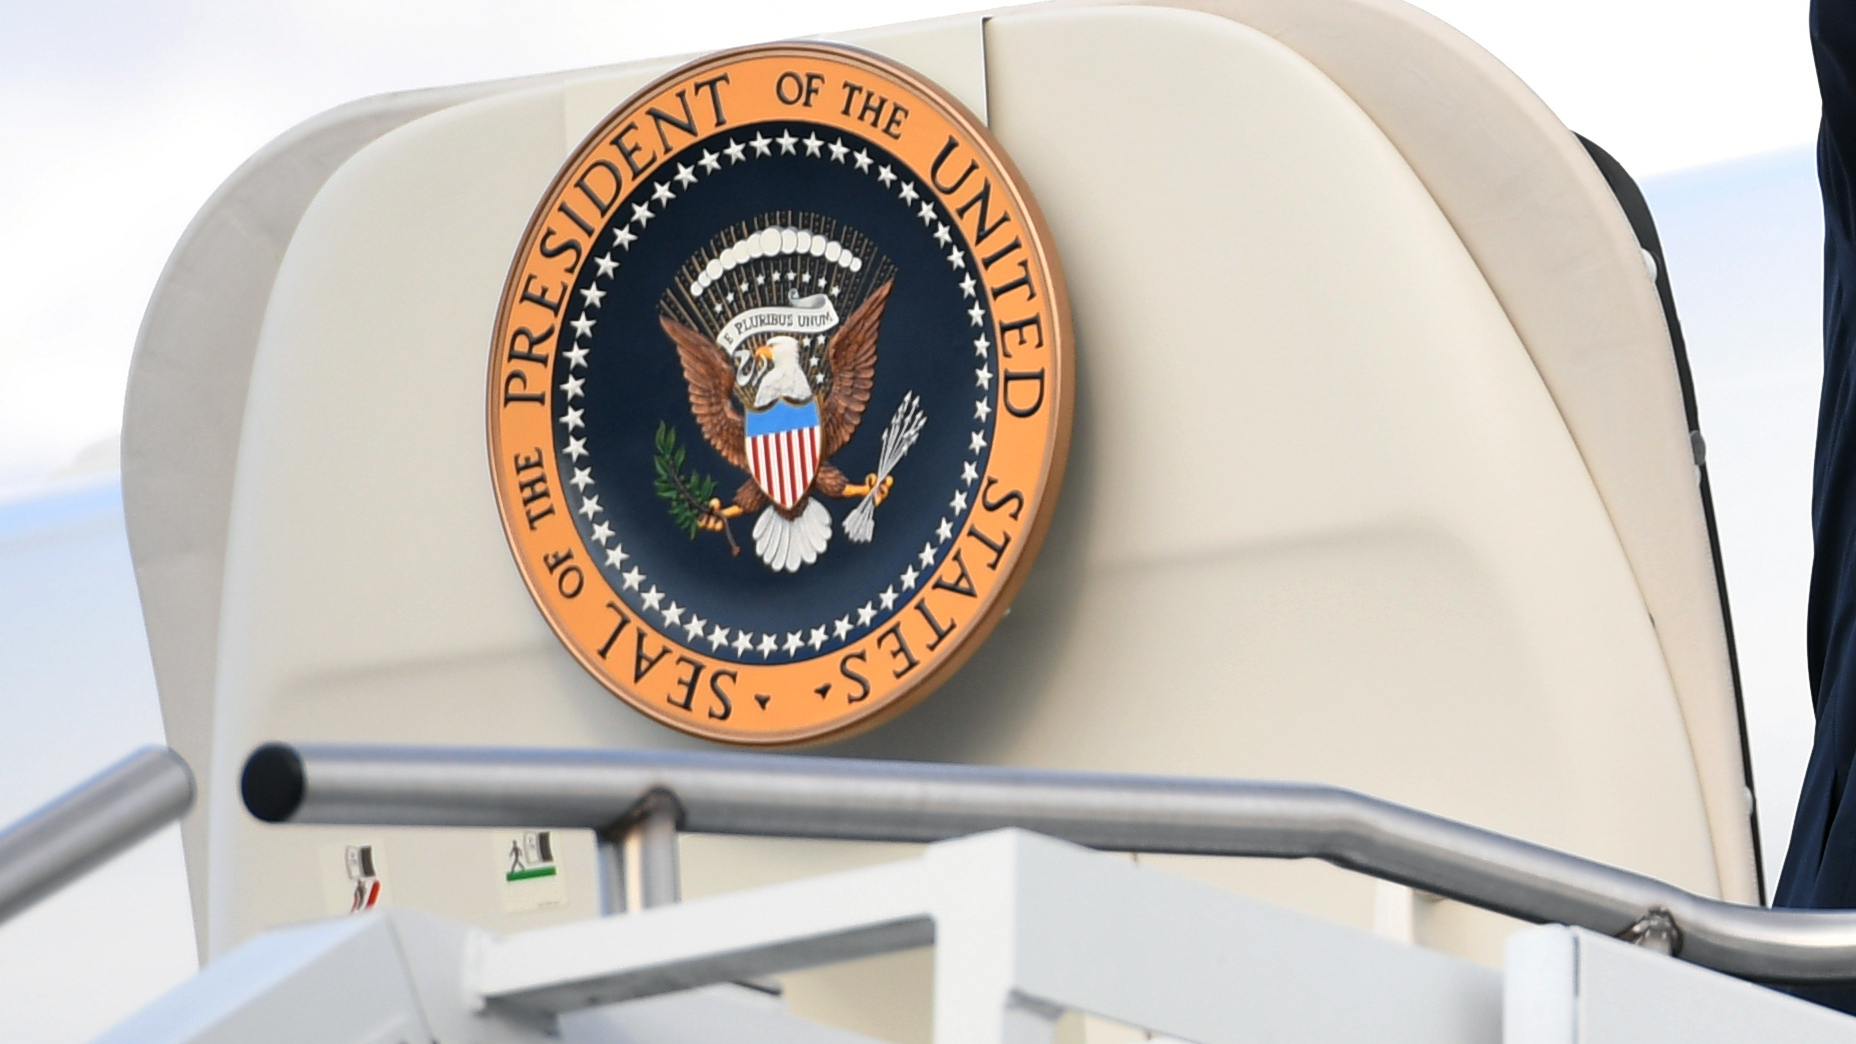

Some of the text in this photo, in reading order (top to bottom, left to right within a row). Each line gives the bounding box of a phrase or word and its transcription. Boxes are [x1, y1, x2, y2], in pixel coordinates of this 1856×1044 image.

[504, 71, 1045, 721] SEAL OF THE PRESIDENT OF THE UNITED STATES
[723, 311, 833, 345] E PLURIBUS UNUM
